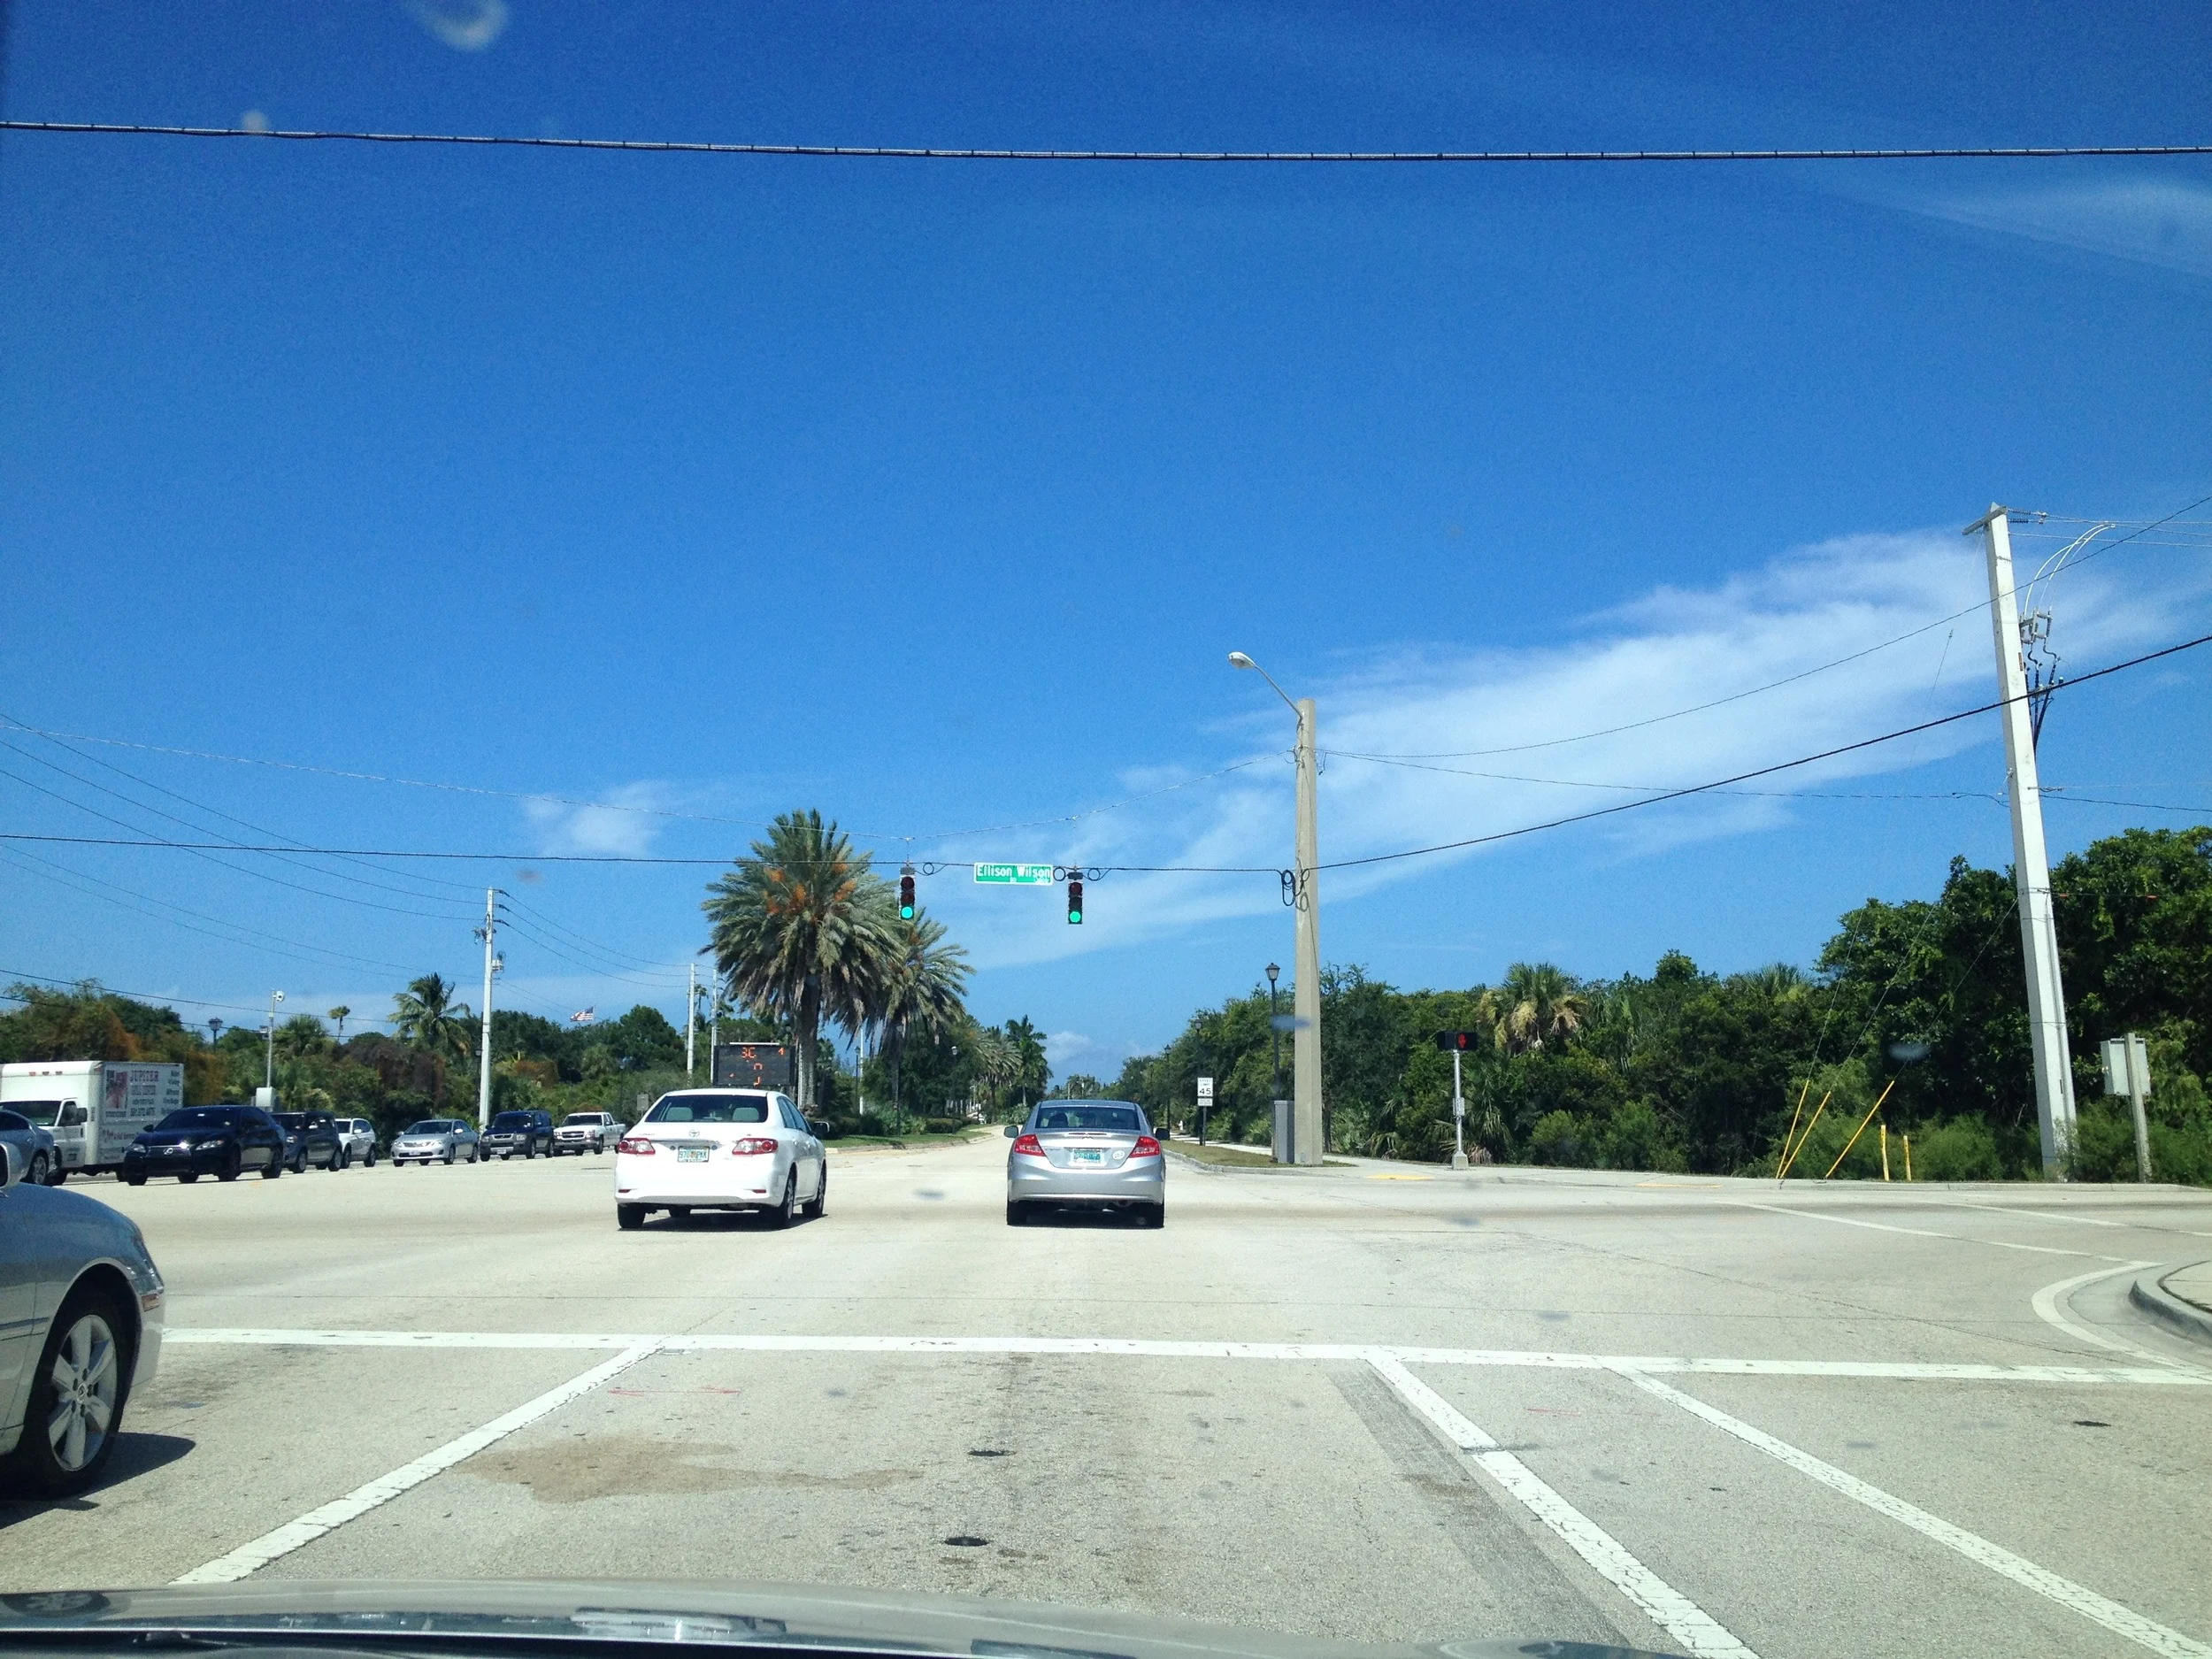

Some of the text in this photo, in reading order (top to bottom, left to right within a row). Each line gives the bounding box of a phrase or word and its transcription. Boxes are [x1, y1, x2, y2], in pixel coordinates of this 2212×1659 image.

[977, 864, 1050, 878] Ellison Wilson
[130, 1070, 158, 1082] JUPITER
